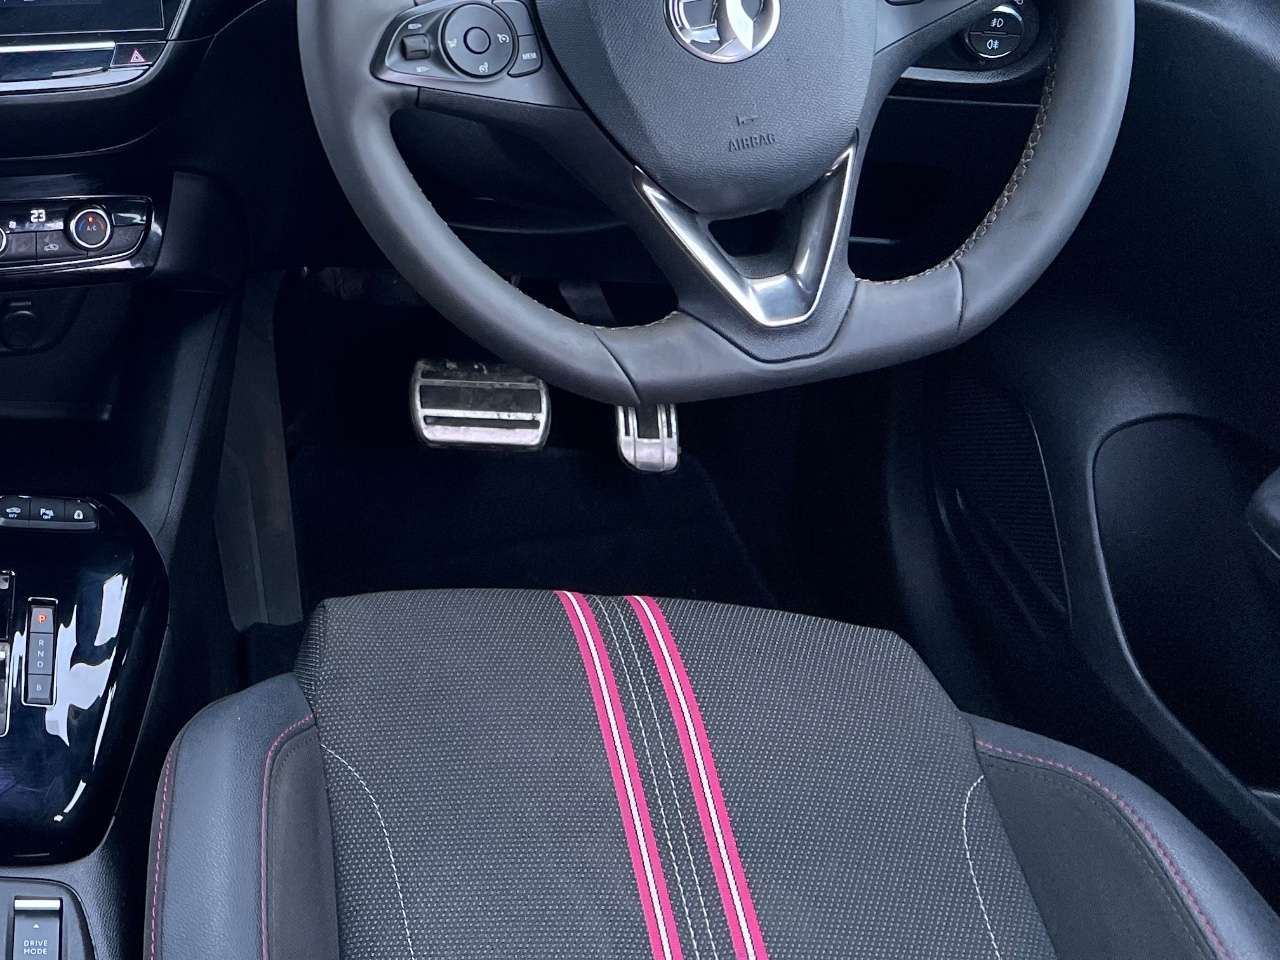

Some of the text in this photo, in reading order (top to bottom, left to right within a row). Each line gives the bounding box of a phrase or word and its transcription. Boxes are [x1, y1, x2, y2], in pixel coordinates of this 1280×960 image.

[728, 134, 776, 152] AIRBAG
[30, 209, 46, 223] 23
[39, 614, 46, 624] P
[38, 639, 45, 647] R
[23, 939, 48, 947] DRIVE
